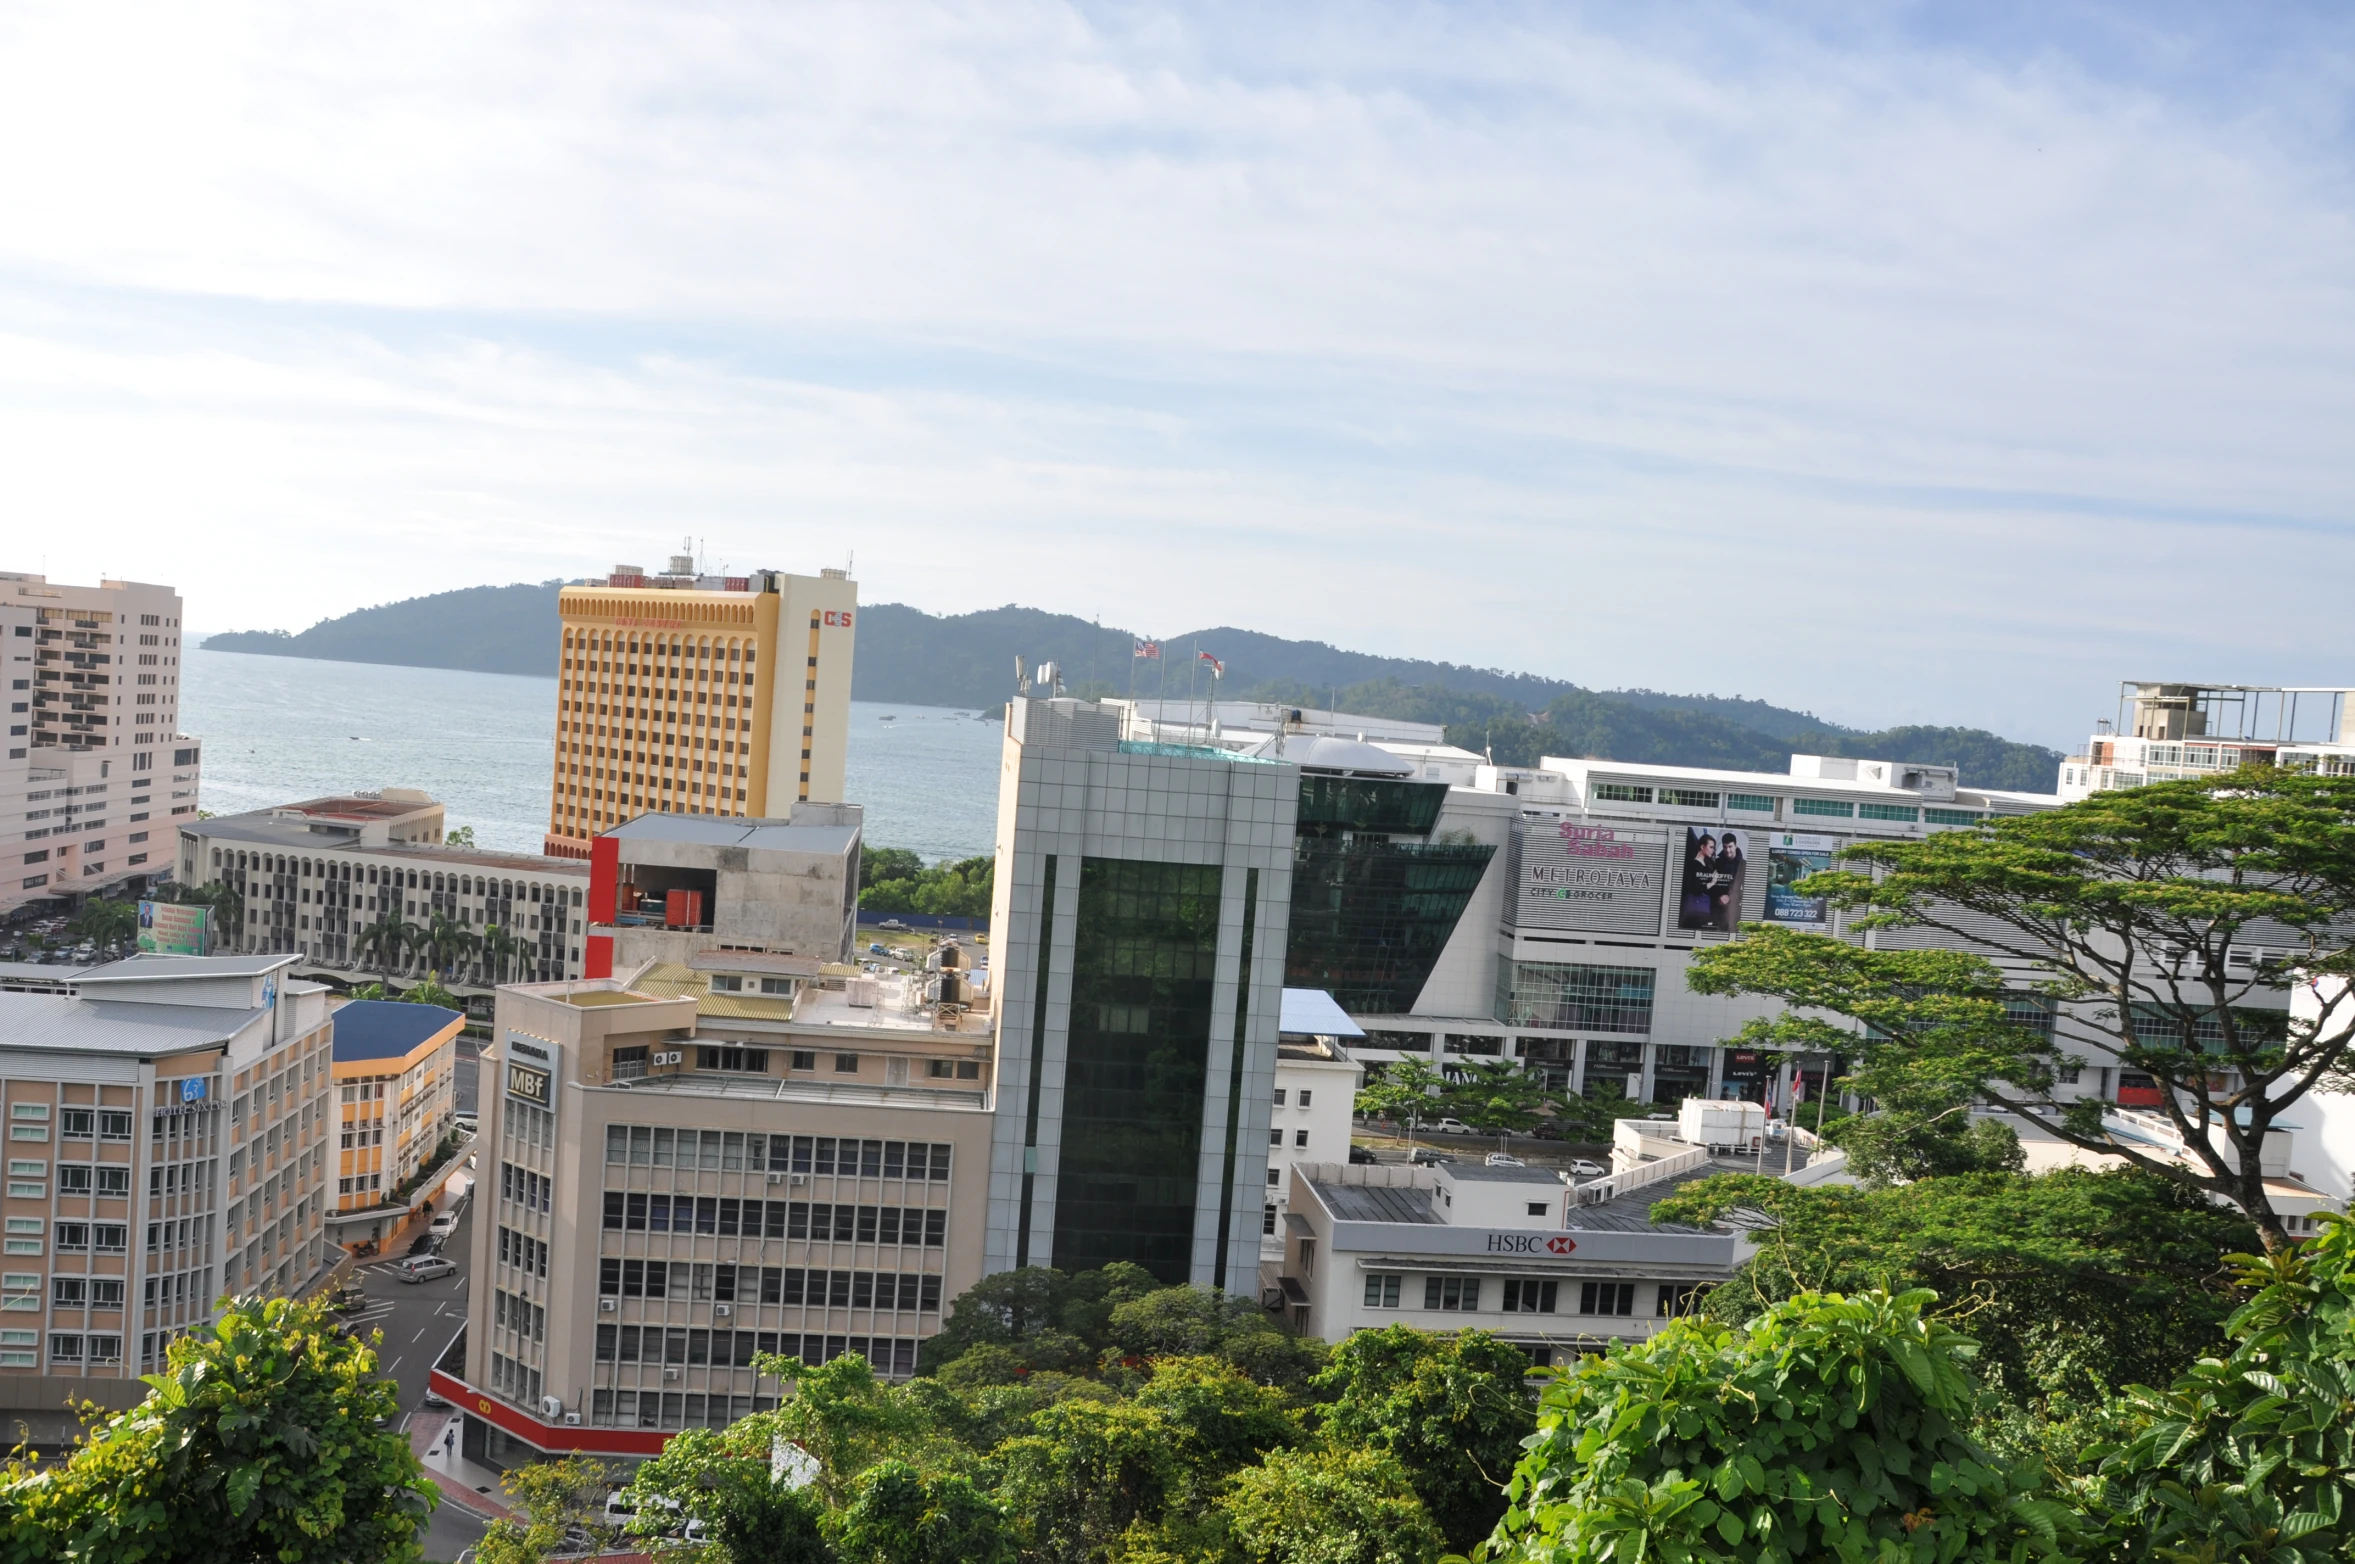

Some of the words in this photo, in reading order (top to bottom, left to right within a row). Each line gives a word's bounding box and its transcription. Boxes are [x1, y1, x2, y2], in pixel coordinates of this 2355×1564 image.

[1559, 821, 1615, 841] Suria
[1567, 839, 1635, 859] Sabah
[1532, 866, 1650, 888] METROJAYA
[1530, 888, 1554, 897] CITY
[1573, 890, 1613, 900] GROCER
[1775, 908, 1789, 916] 088
[1789, 909, 1803, 917] 723
[1804, 910, 1818, 918] 322
[511, 1068, 544, 1097] MBf
[155, 1104, 191, 1118] HOTEL
[1487, 1233, 1543, 1254] HSBC
